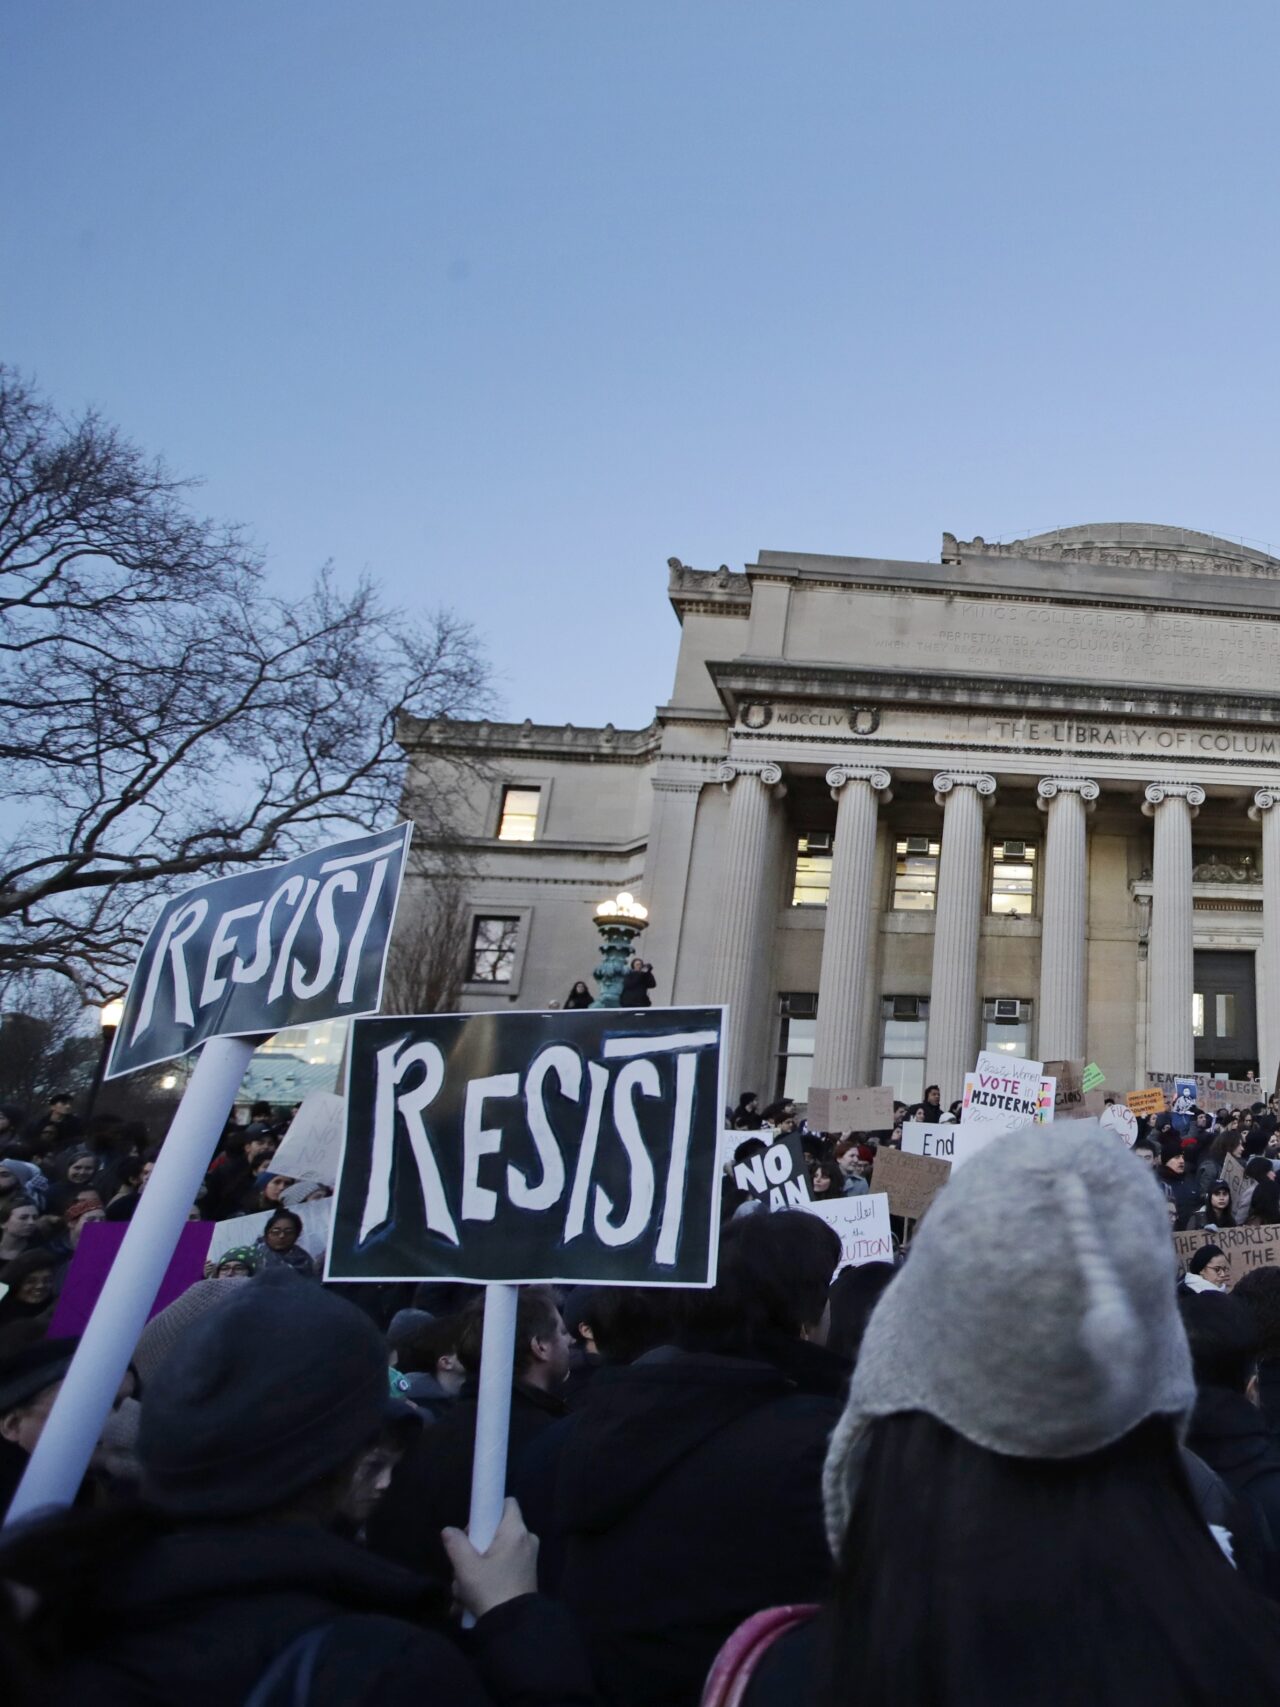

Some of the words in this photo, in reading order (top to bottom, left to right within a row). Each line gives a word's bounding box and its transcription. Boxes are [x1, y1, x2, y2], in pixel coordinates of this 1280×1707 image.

[1026, 609, 1102, 626] COLLEGE
[1114, 615, 1192, 632] FOUNDED
[1228, 623, 1260, 637] THE
[1056, 637, 1132, 653] COLUMBIA
[1141, 643, 1210, 658] COLLEGE
[777, 713, 843, 726] MDCCLIV
[995, 720, 1039, 740] THE
[1053, 723, 1147, 745] LIBRARY
[1157, 730, 1185, 747] OF
[131, 838, 404, 1048] RESIST
[979, 1073, 1021, 1095] VOTE
[1207, 1079, 1260, 1095] COLLEGE
[971, 1089, 1036, 1115] MIDTERMS
[1110, 1106, 1136, 1129] FUCK
[359, 1031, 718, 1265] RESIST
[923, 1131, 955, 1156] End
[734, 1144, 793, 1194] NO
[769, 1174, 811, 1212] AN
[1242, 1248, 1274, 1267] THE
